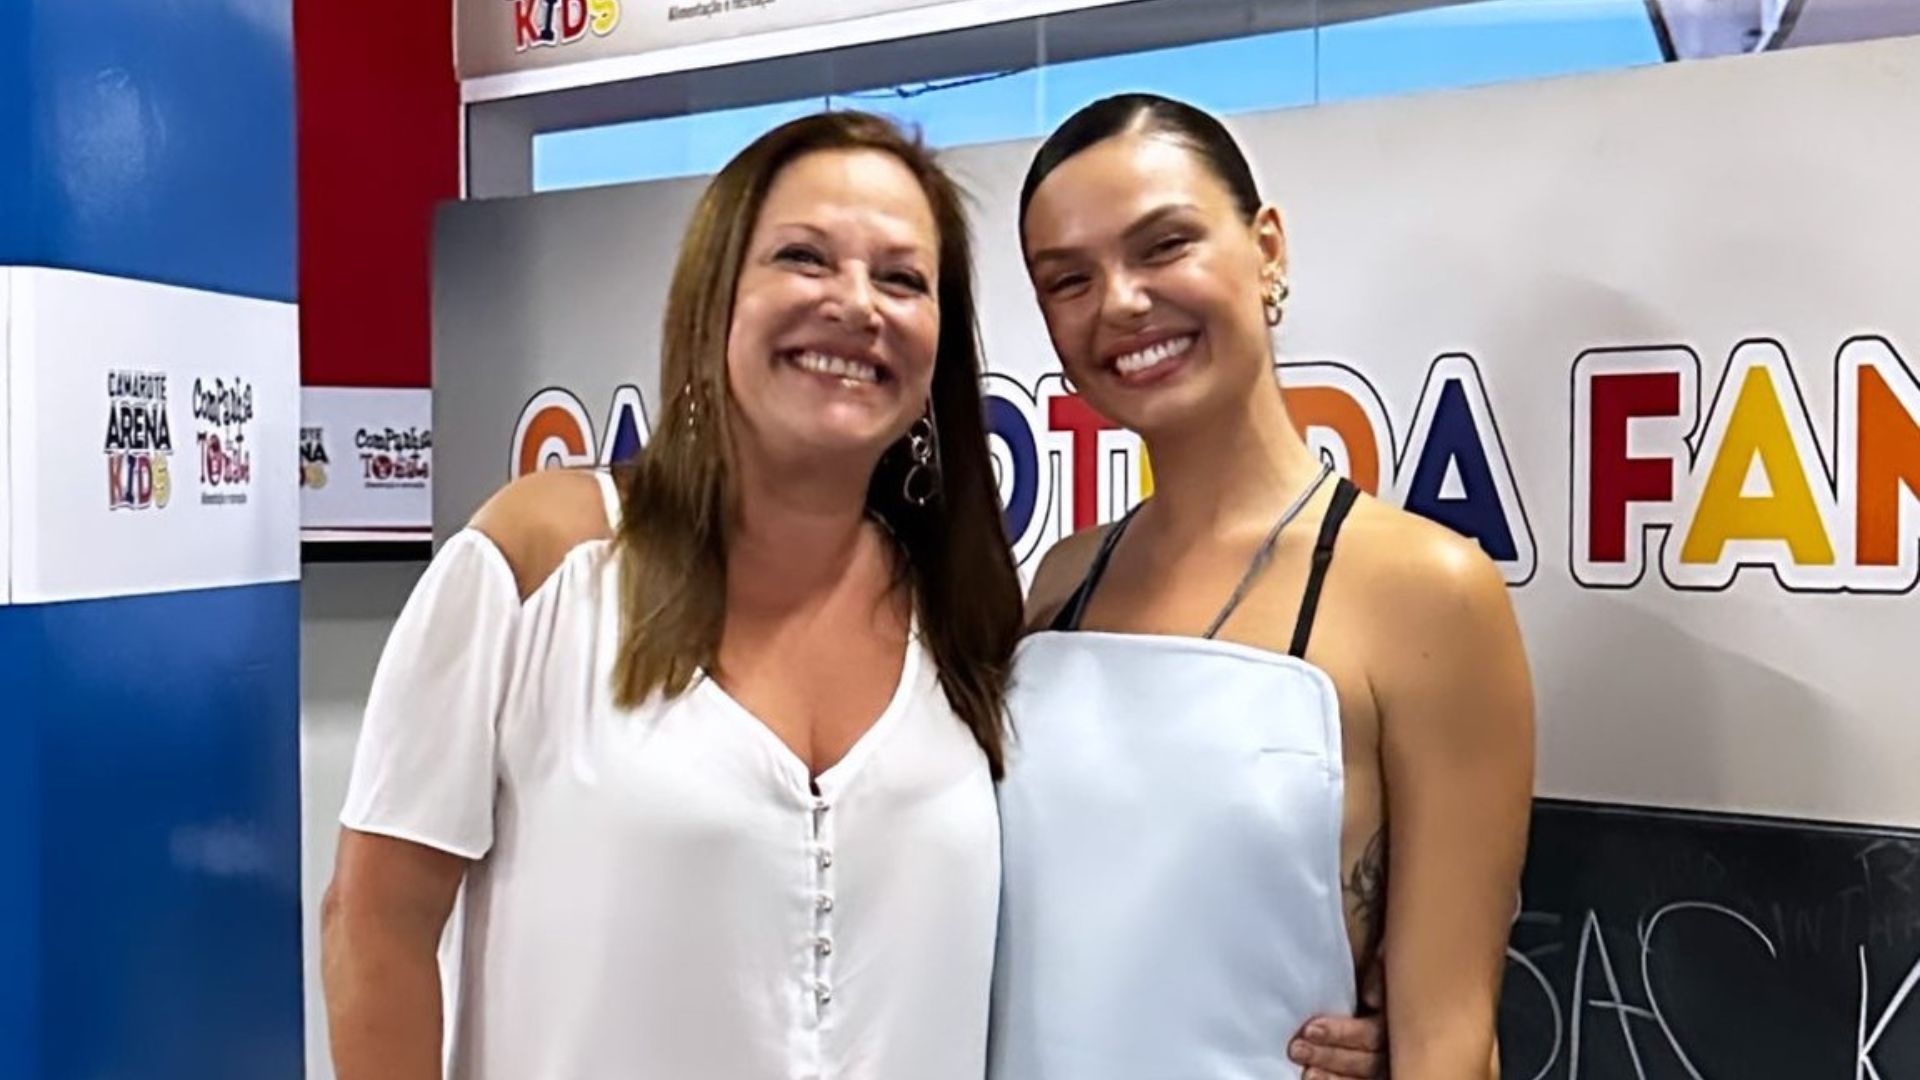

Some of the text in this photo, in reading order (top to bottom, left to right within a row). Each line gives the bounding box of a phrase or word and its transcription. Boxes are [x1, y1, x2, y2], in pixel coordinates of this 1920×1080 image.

[513, 0, 621, 52] KIDS
[108, 371, 168, 401] CAMAROTE
[105, 402, 173, 454] ARENA
[108, 454, 172, 510] KIDS
